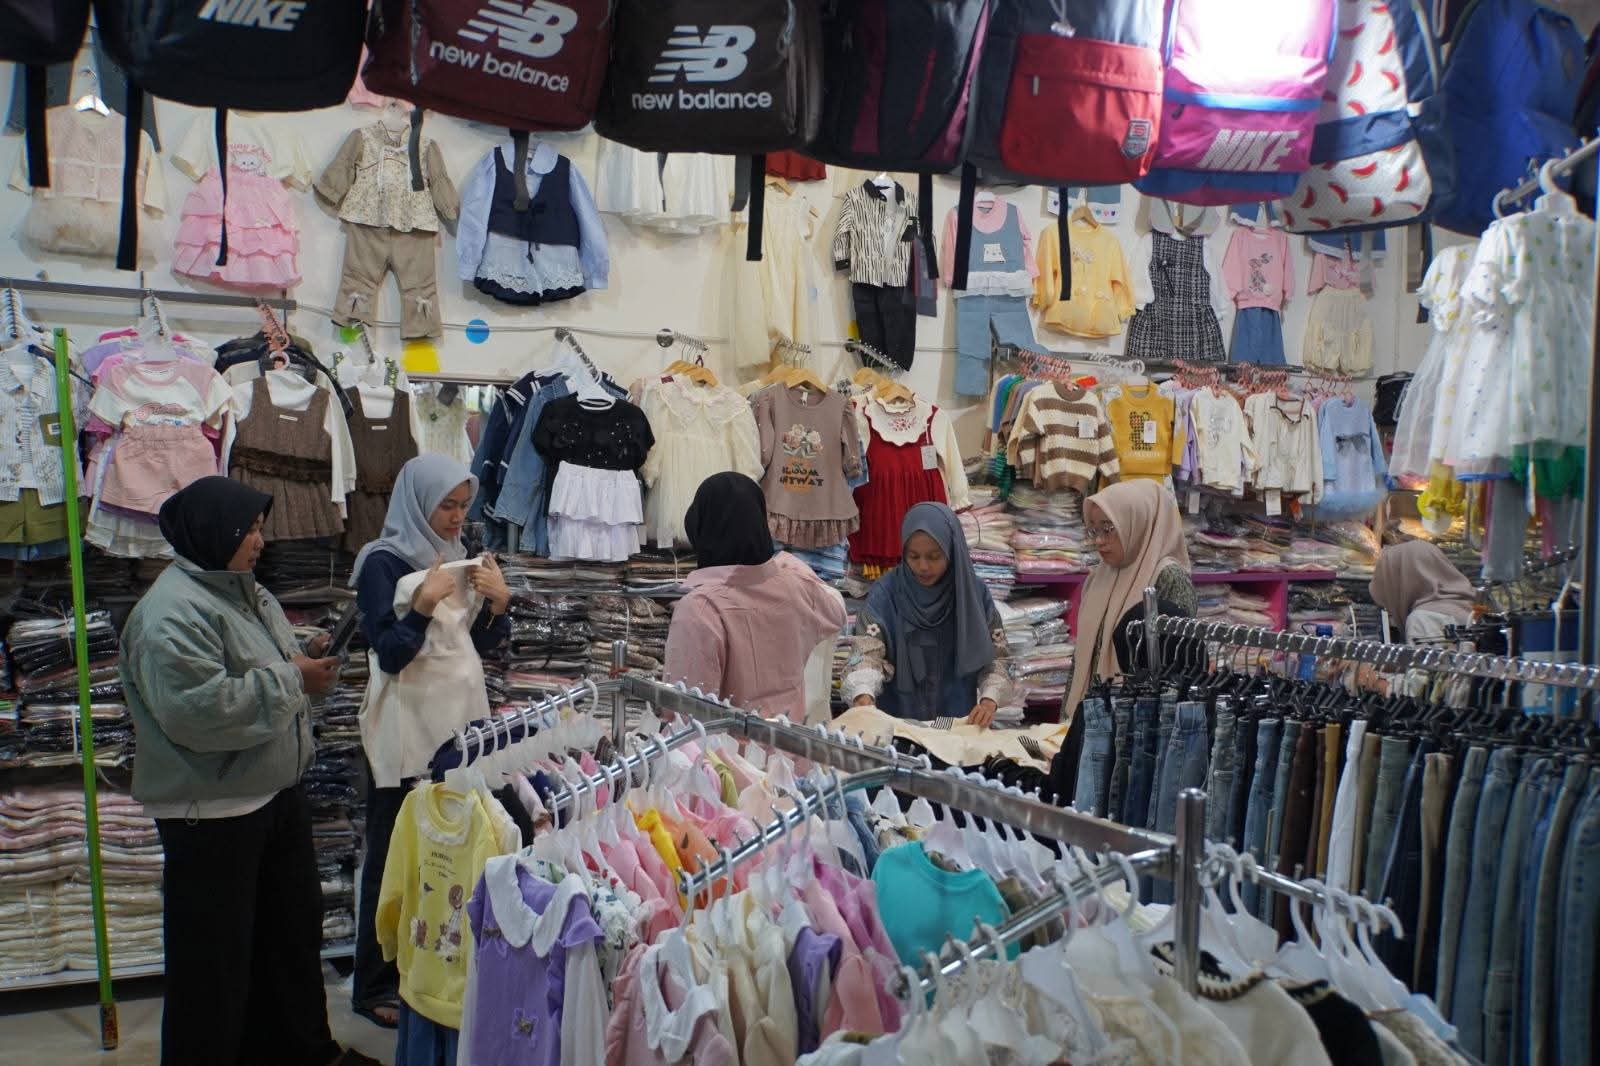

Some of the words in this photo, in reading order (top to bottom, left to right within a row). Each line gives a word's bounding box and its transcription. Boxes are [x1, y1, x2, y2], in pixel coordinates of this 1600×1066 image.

[197, 0, 307, 31] NIKE
[429, 41, 480, 69] new
[482, 52, 570, 93] balance
[647, 25, 756, 83] NB
[631, 92, 674, 110] new
[679, 88, 773, 110] balance
[1197, 128, 1299, 172] NIKE
